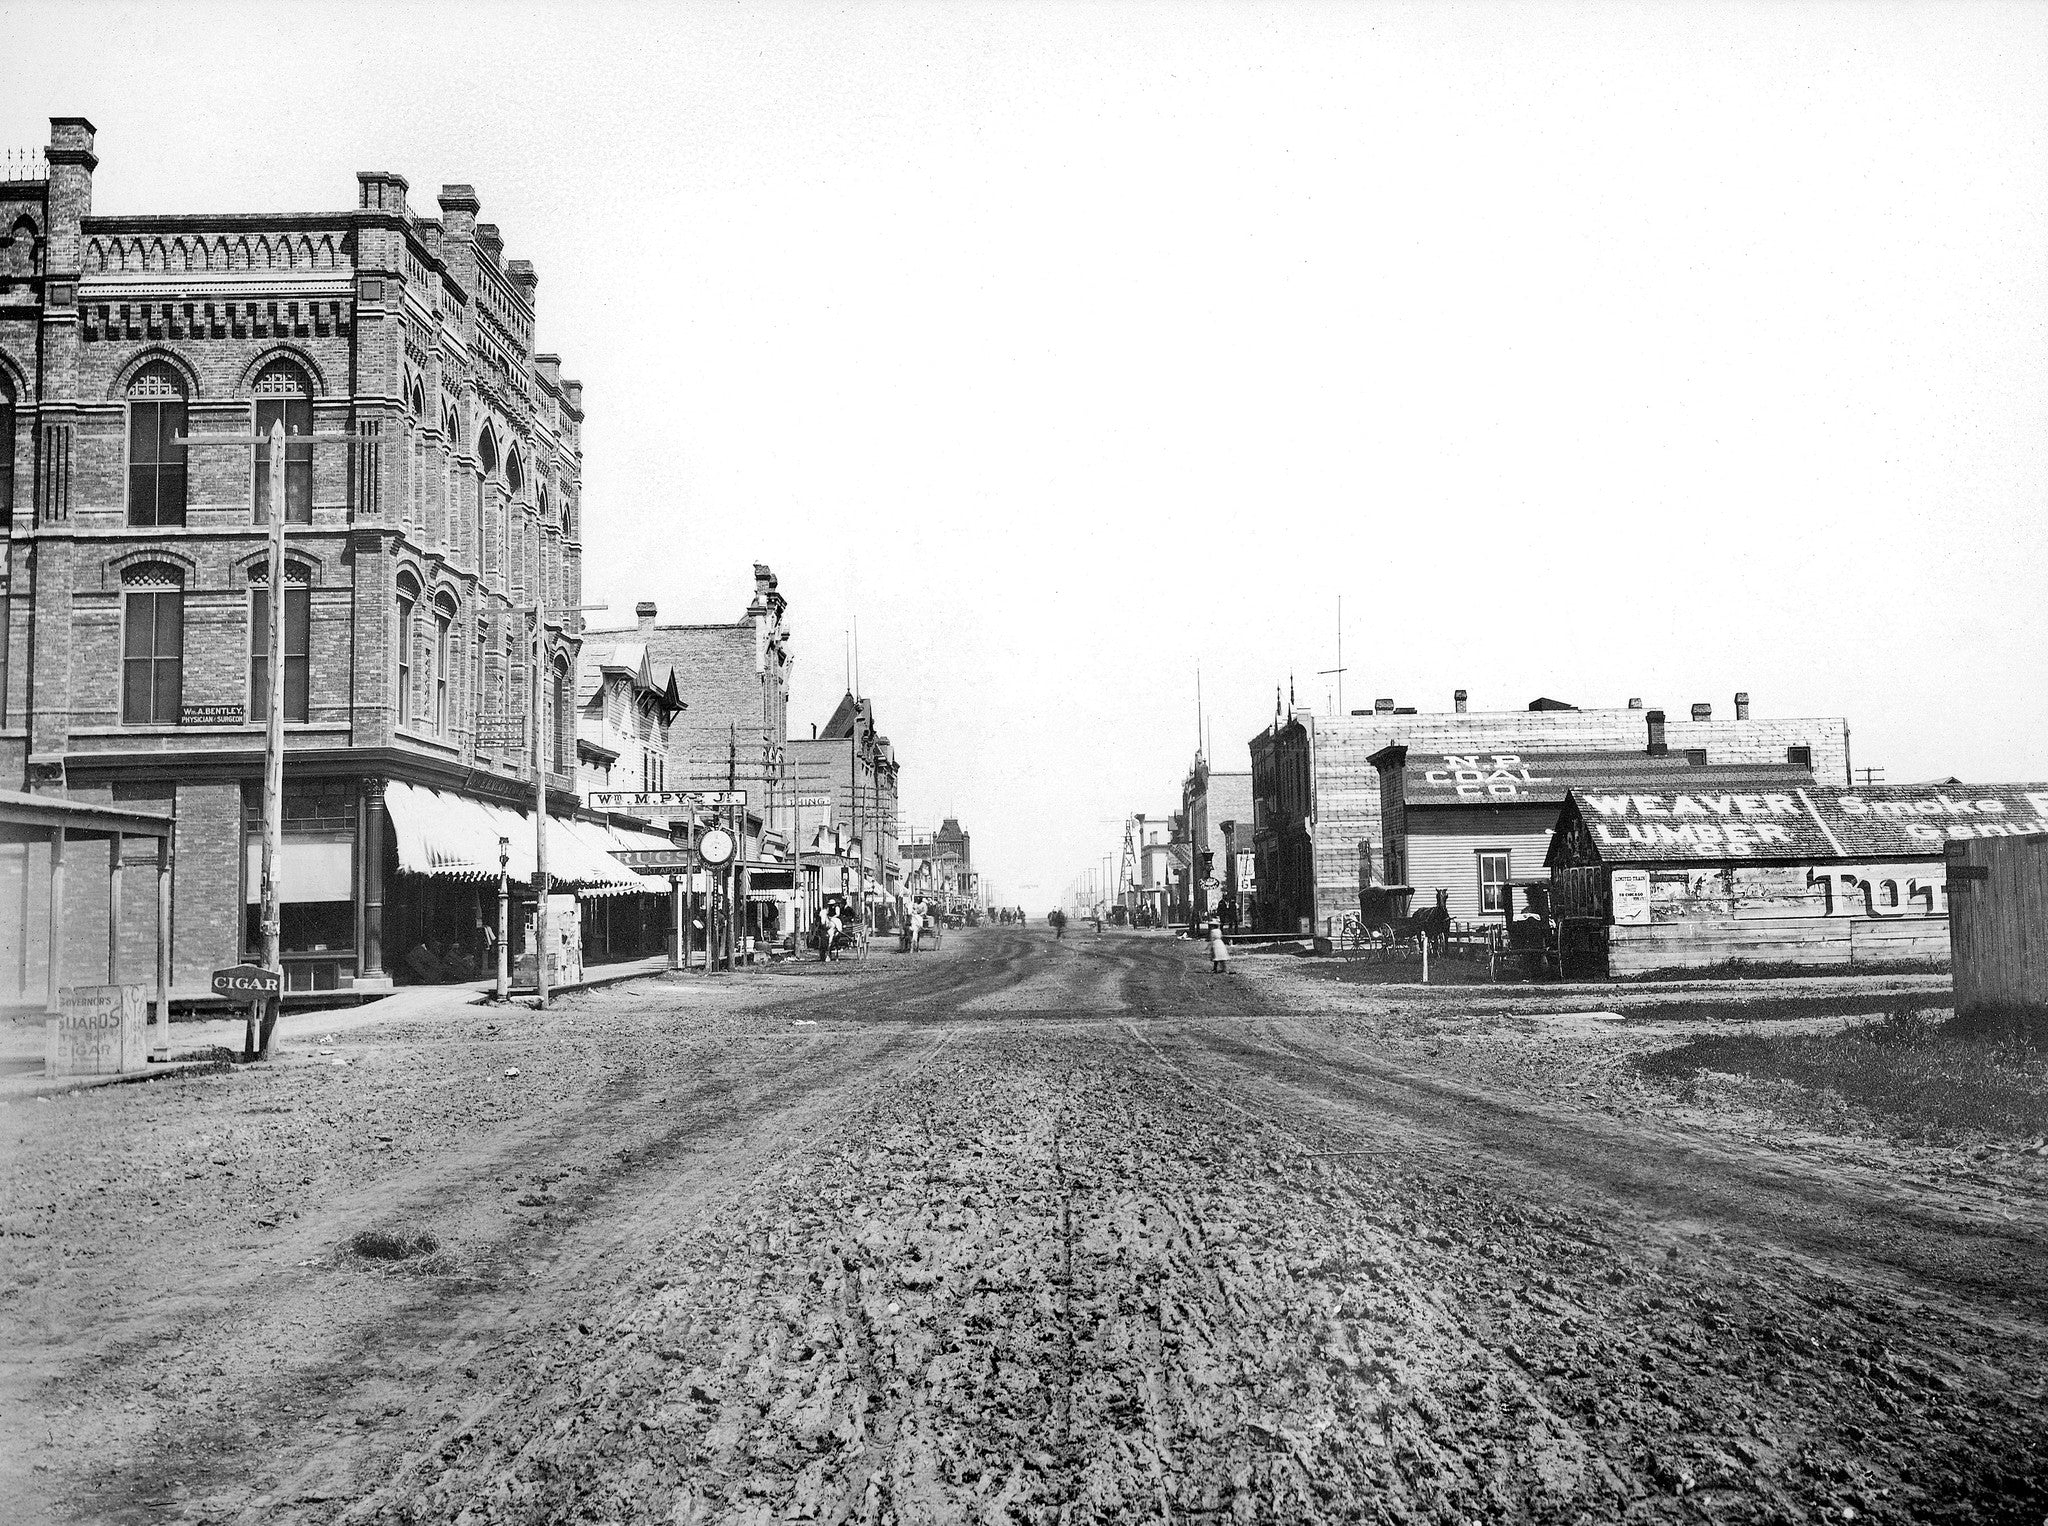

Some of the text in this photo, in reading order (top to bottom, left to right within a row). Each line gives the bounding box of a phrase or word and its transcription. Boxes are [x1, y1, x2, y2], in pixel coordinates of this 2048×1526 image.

[1425, 769, 1552, 783] COAL
[1456, 785, 1529, 795] CO.
[1582, 794, 1803, 816] WEAVER
[1838, 794, 2006, 815] Smoke
[1595, 822, 1796, 845] LUMBER
[615, 851, 693, 864] RUGS
[660, 866, 700, 874] APOTHK
[213, 976, 278, 991] CIGAR
